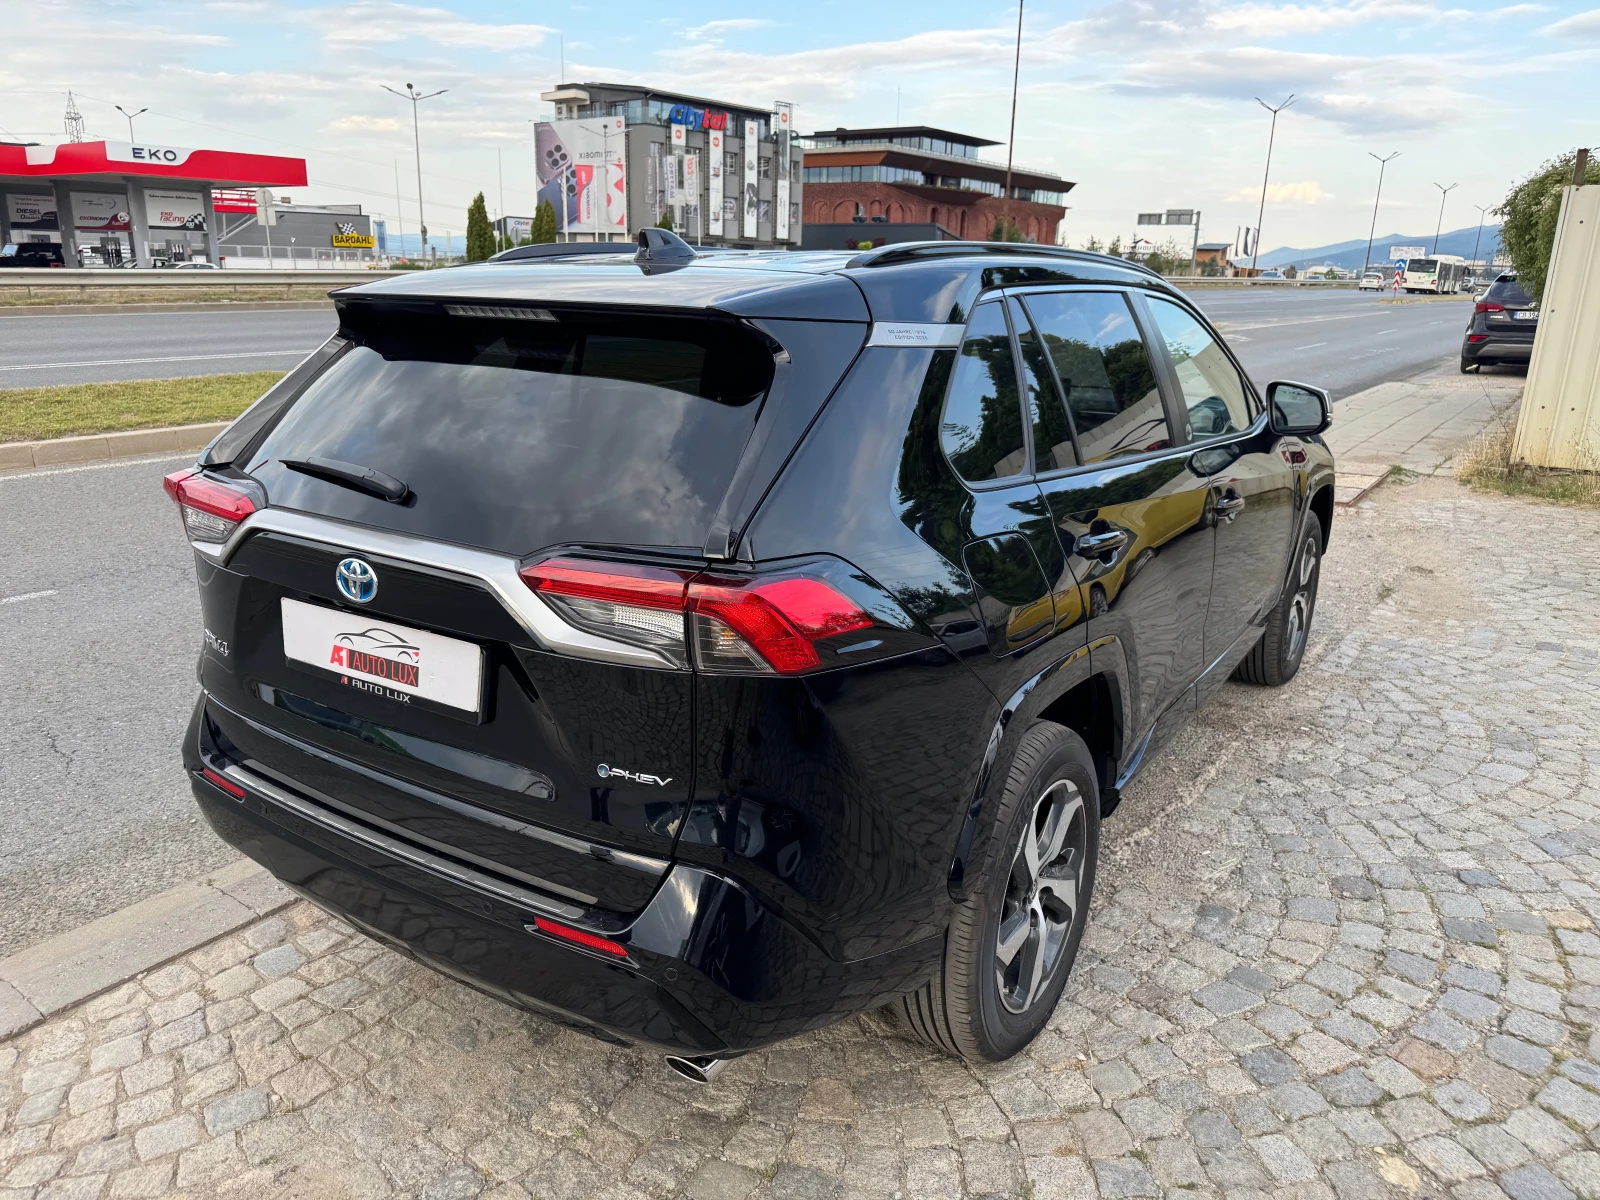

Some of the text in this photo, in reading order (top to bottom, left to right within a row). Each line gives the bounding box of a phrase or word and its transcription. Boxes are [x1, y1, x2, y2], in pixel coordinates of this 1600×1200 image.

[132, 147, 177, 162] EKO
[159, 216, 185, 224] racing
[334, 235, 373, 246] BARDAHL
[352, 651, 387, 678] AUTO
[391, 661, 418, 687] LUX
[352, 679, 383, 695] AUTO
[386, 689, 411, 704] LUX
[609, 767, 674, 787] PHEV
